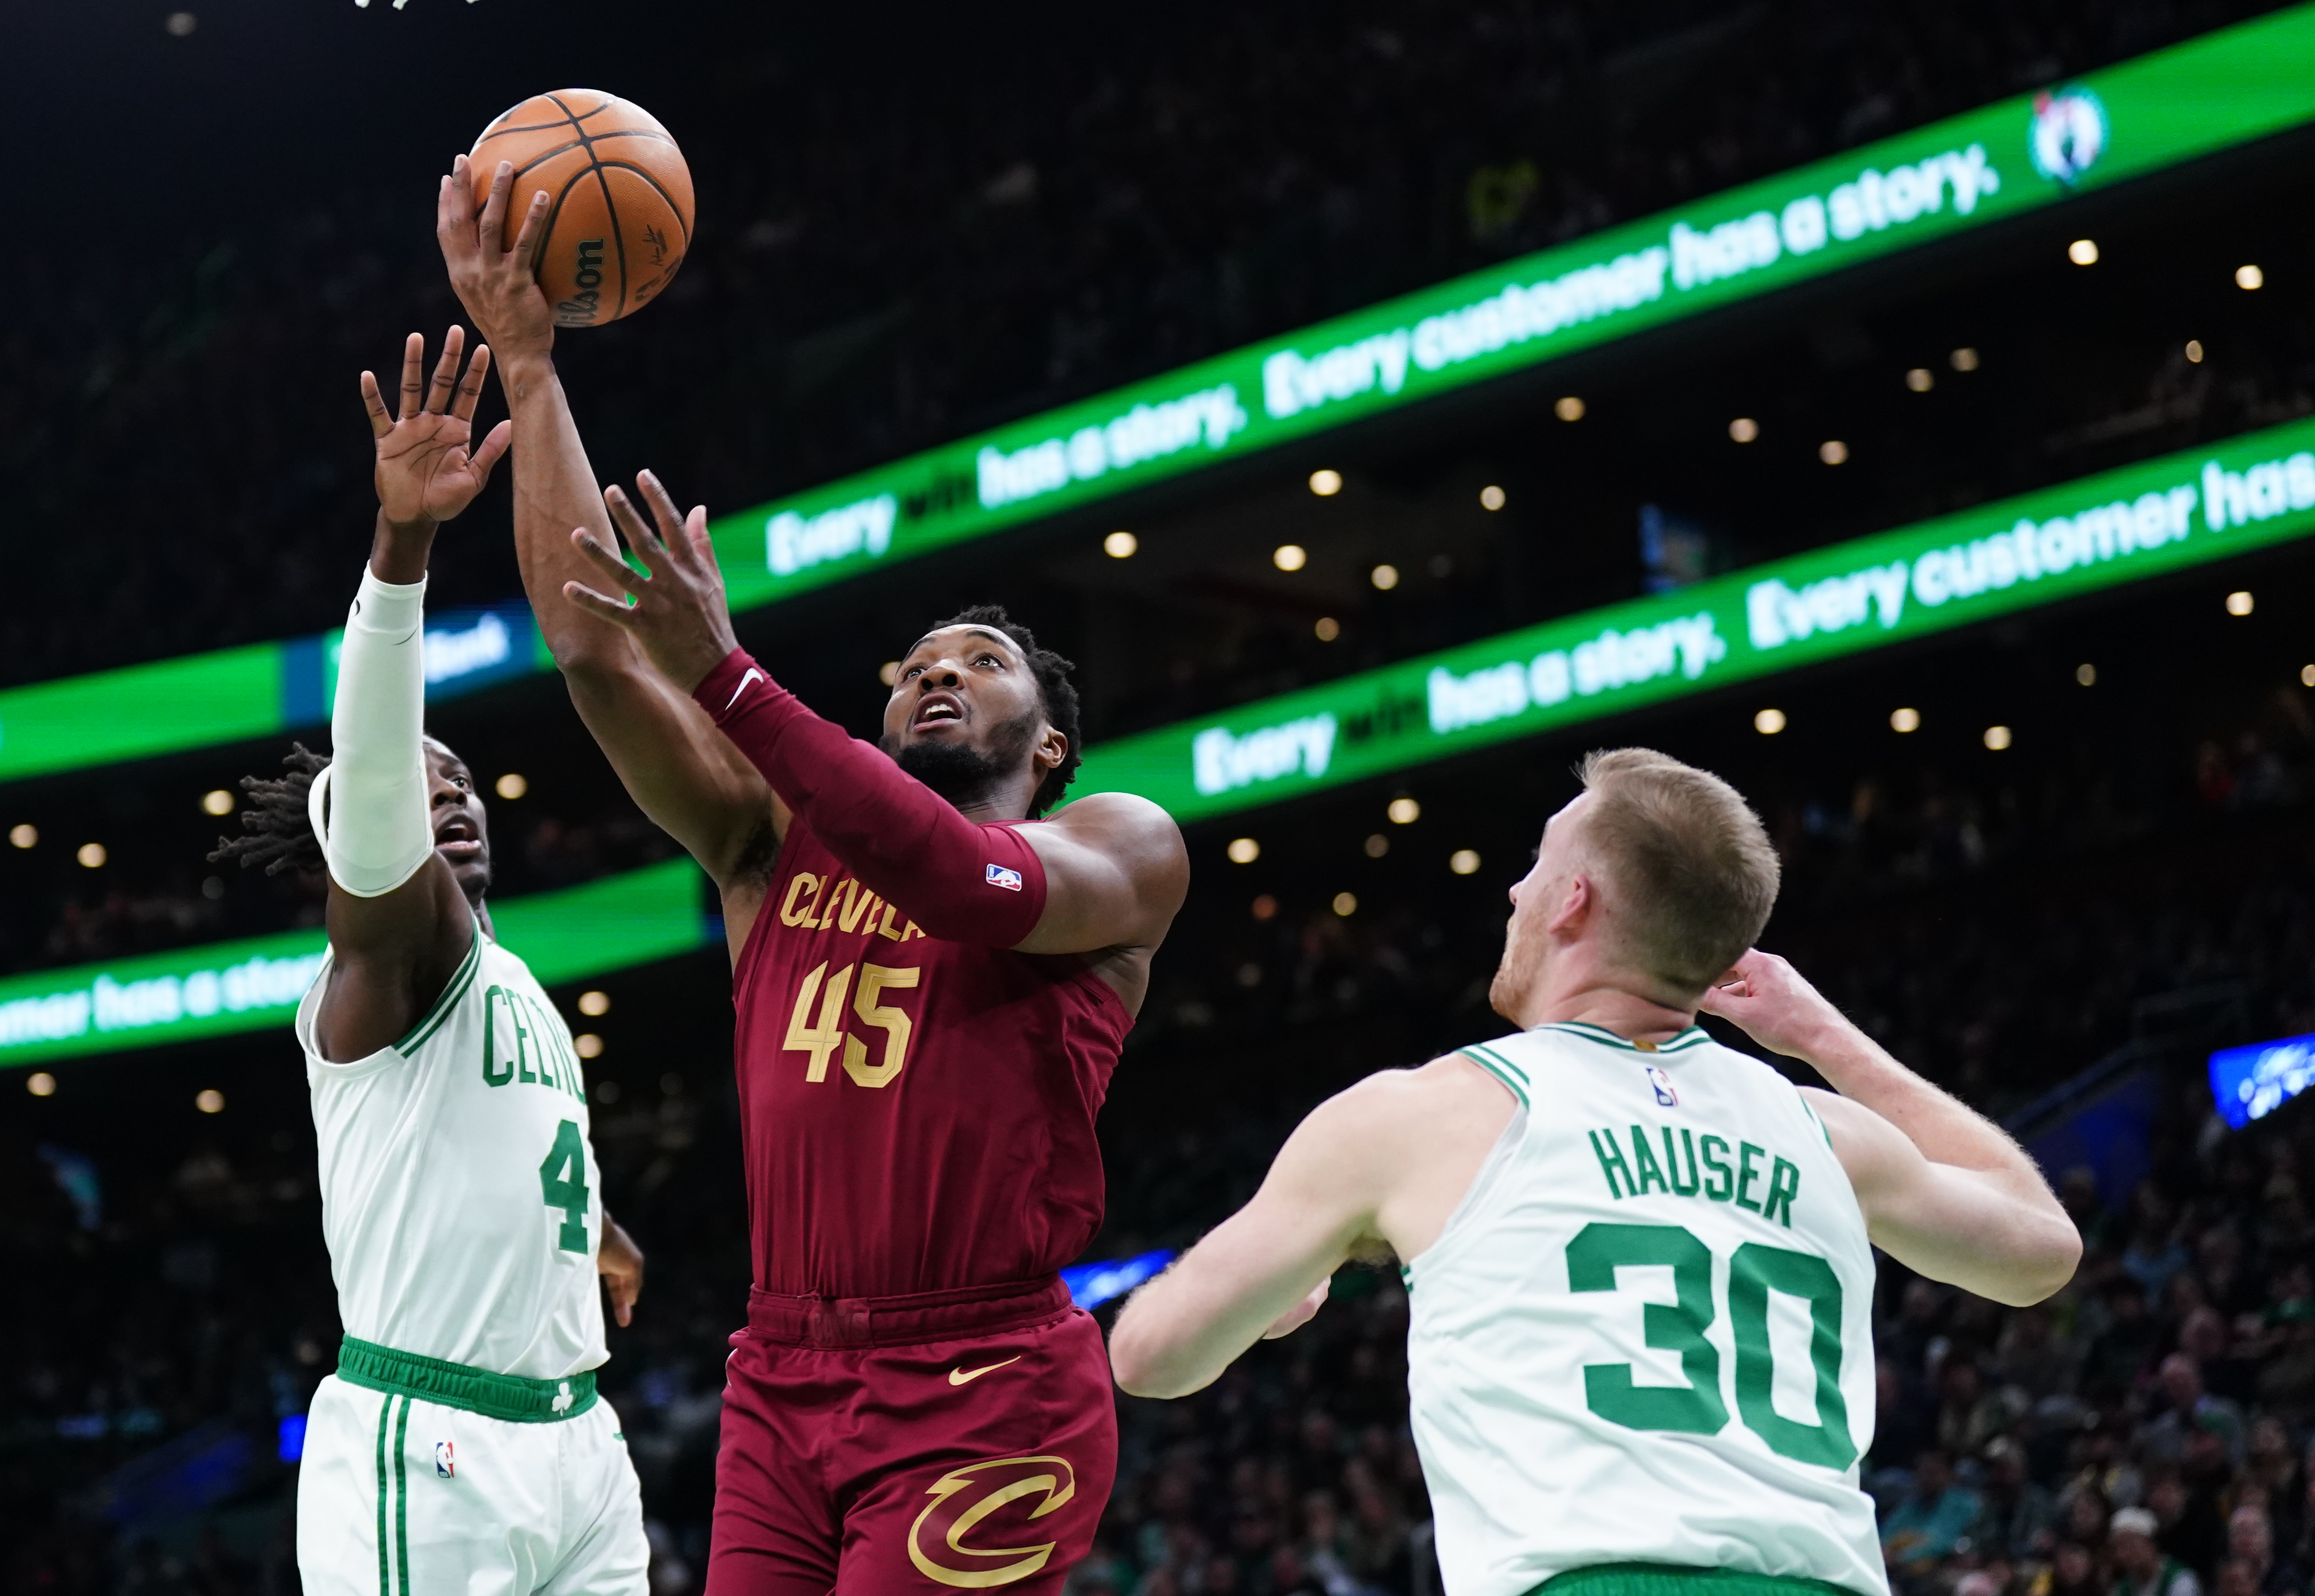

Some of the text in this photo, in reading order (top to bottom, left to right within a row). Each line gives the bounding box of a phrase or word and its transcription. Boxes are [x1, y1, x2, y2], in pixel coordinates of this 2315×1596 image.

[553, 237, 605, 327] ilson
[767, 498, 894, 573] Every
[979, 441, 1067, 504] has
[1067, 428, 1107, 478] a
[1107, 387, 1246, 468] story.
[1264, 332, 1411, 416] Every
[1412, 248, 1668, 369] customer
[1670, 214, 1781, 287] has
[1781, 197, 1826, 252] a
[1828, 144, 1999, 239] story.
[1194, 716, 1336, 792] Every
[1428, 663, 1528, 731] has
[1529, 652, 1571, 704] a
[1572, 614, 1725, 692] story.
[1747, 564, 1907, 648] Every
[1912, 486, 2197, 604] customer
[2203, 454, 2315, 529] has
[782, 960, 920, 1088] 45
[539, 1119, 589, 1255] 4
[1588, 1125, 1801, 1229] HAUSER
[1565, 1222, 1859, 1473] 30
